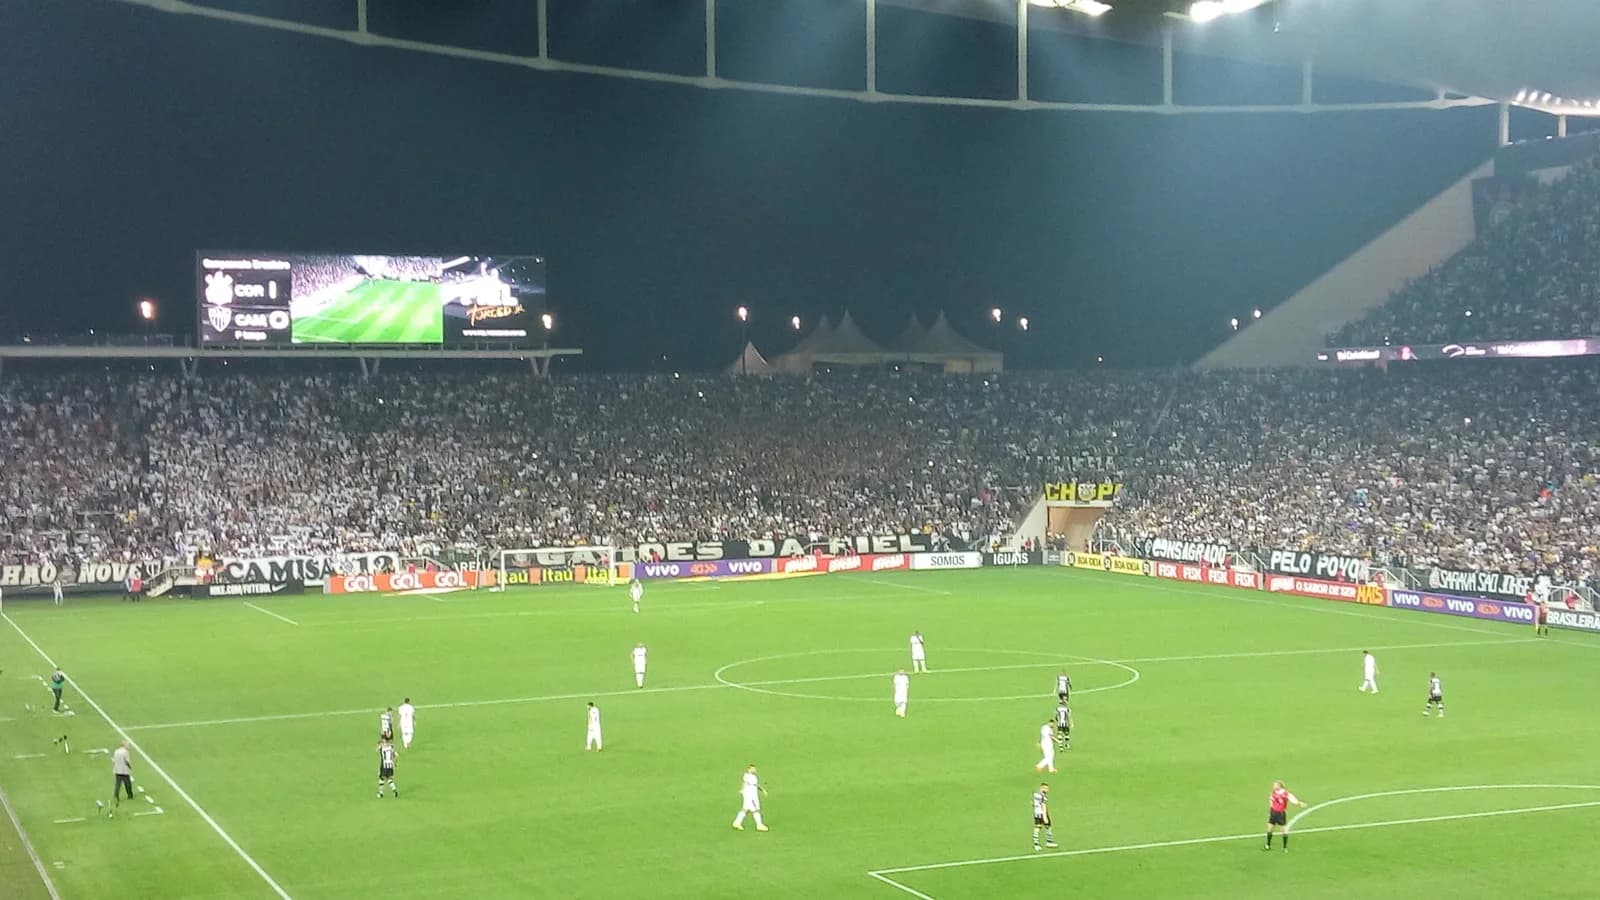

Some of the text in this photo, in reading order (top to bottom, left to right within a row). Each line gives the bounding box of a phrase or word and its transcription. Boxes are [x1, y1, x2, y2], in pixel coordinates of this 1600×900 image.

[749, 538, 806, 558] DA
[829, 535, 926, 556] FIEL
[930, 555, 965, 566] SOMOS
[993, 552, 1029, 566] IGUAIS
[1270, 550, 1360, 579] PELO POVO
[78, 561, 142, 583] NOVE
[542, 566, 574, 583] Itaú
[645, 564, 680, 577] VIVO
[728, 561, 762, 574] VIVO
[1158, 563, 1178, 578] FISK
[1182, 566, 1202, 581] FISK
[343, 574, 379, 593] GOL
[390, 572, 424, 590] GOL
[434, 570, 468, 588] GOL
[1208, 569, 1229, 584] FISK
[1234, 572, 1256, 588] FISK
[1303, 583, 1329, 595] SABOR
[1329, 585, 1340, 596] DE
[1340, 586, 1357, 598] SER
[1357, 585, 1384, 605] MAIS
[1394, 592, 1420, 606] VIVO
[1446, 599, 1475, 613] VIVO
[1503, 605, 1533, 620] VIVO
